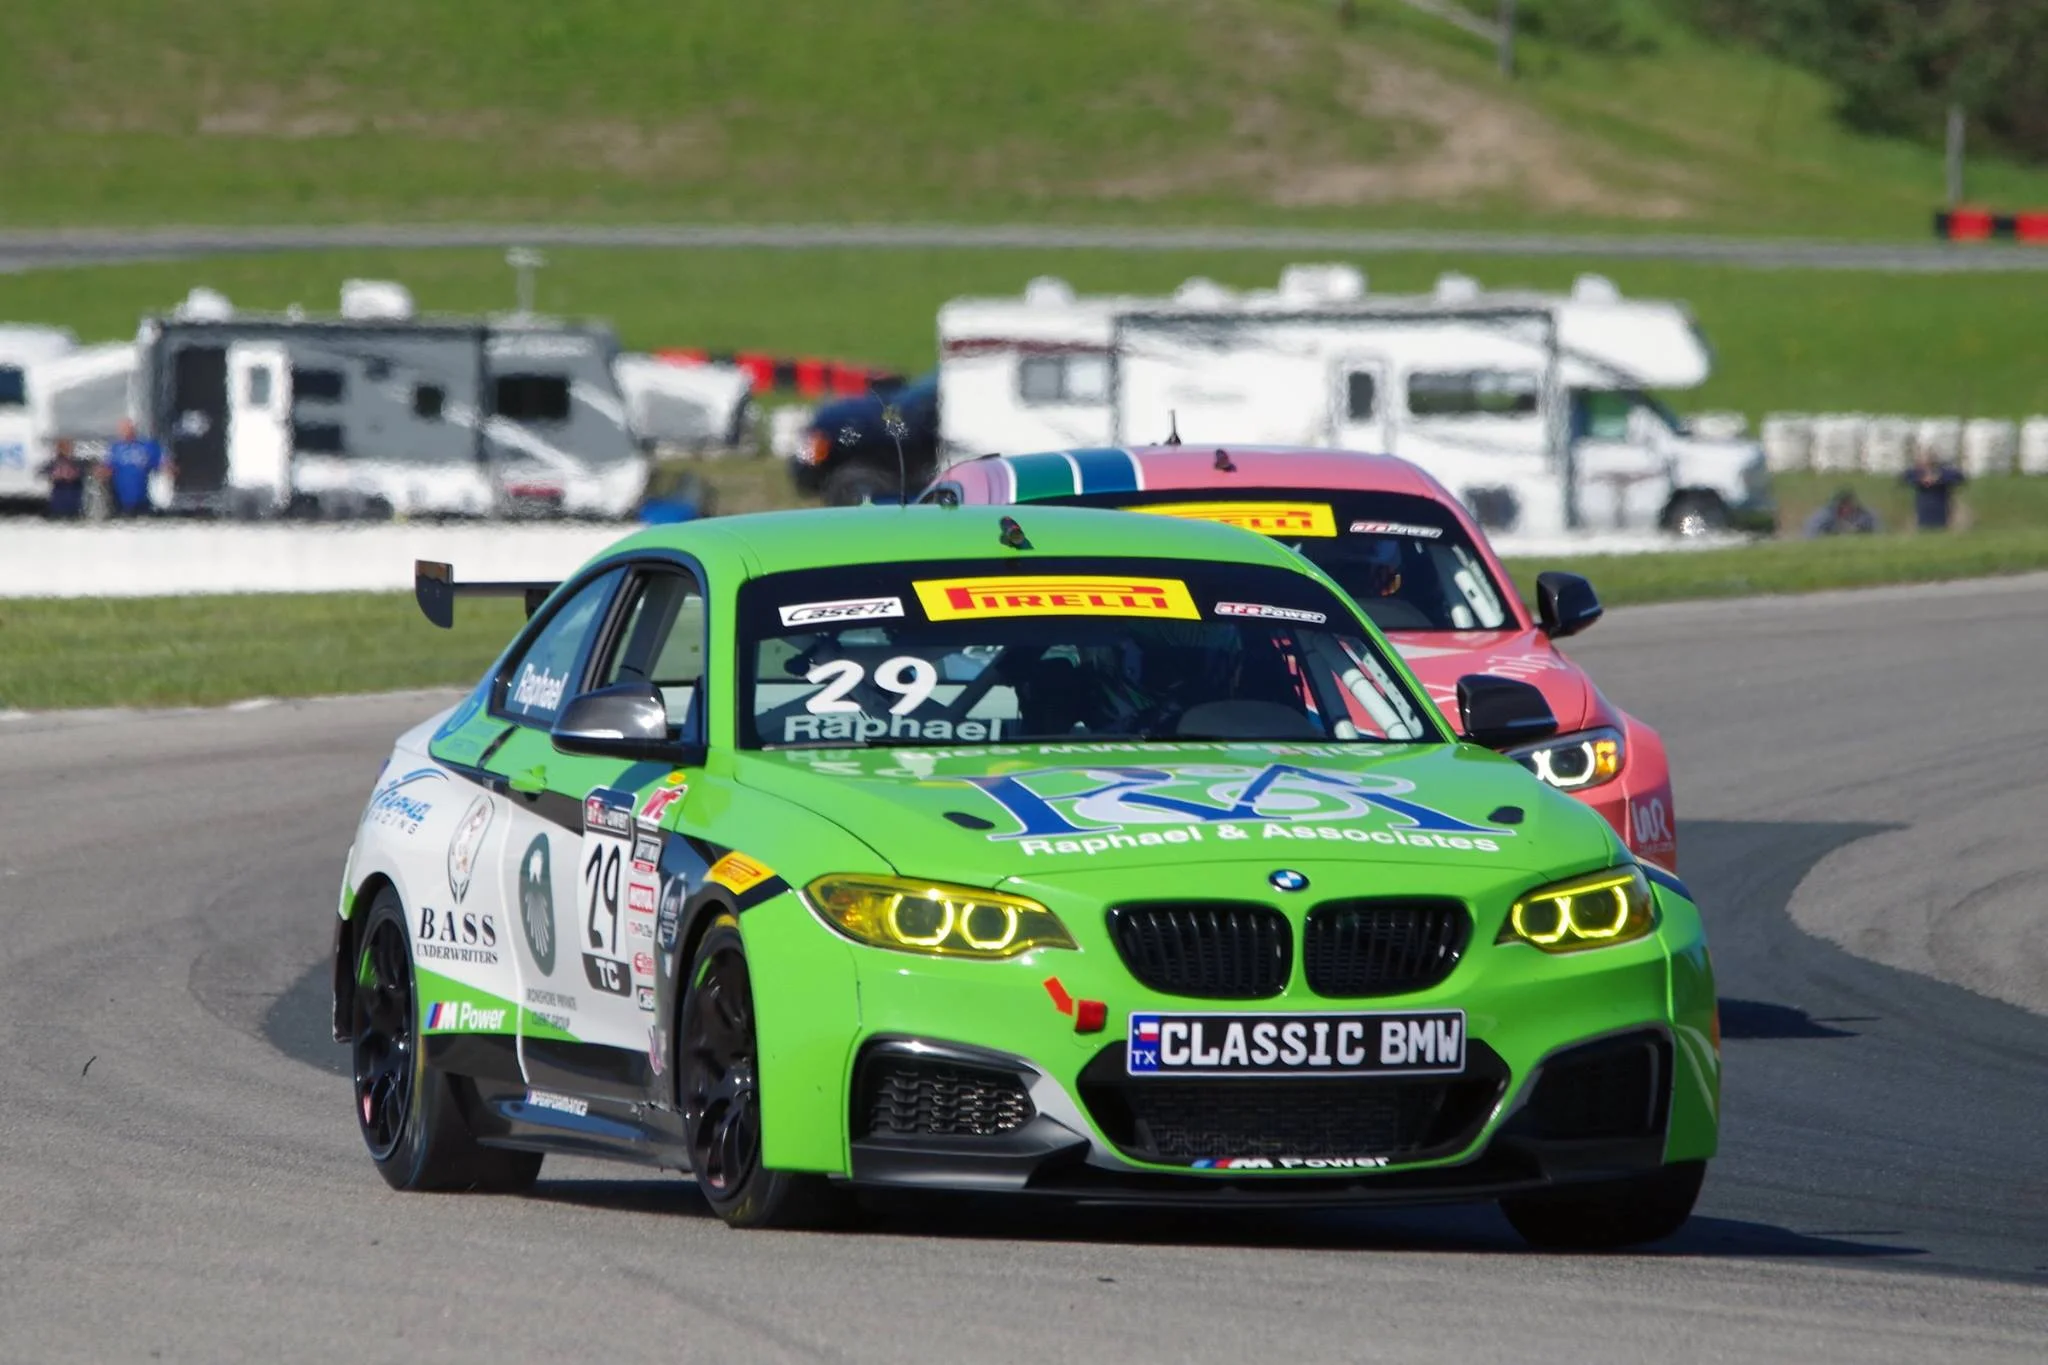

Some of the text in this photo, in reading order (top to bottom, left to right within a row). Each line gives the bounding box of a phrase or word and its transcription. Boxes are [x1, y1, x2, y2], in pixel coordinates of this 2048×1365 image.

[944, 584, 1170, 611] PIRELLI
[514, 662, 569, 715] Raphael
[806, 656, 938, 716] 29
[783, 711, 1003, 743] Raphael
[1022, 823, 1501, 856] Raphael & Associates
[584, 842, 621, 956] 29
[418, 907, 497, 948] BASS
[416, 942, 499, 966] UNDERWRITERS
[595, 959, 621, 991] TC
[459, 1001, 507, 1030] Power
[1131, 1049, 1157, 1065] TX
[1160, 1020, 1461, 1066] CLASSIC BMW
[1277, 1156, 1391, 1169] Power
